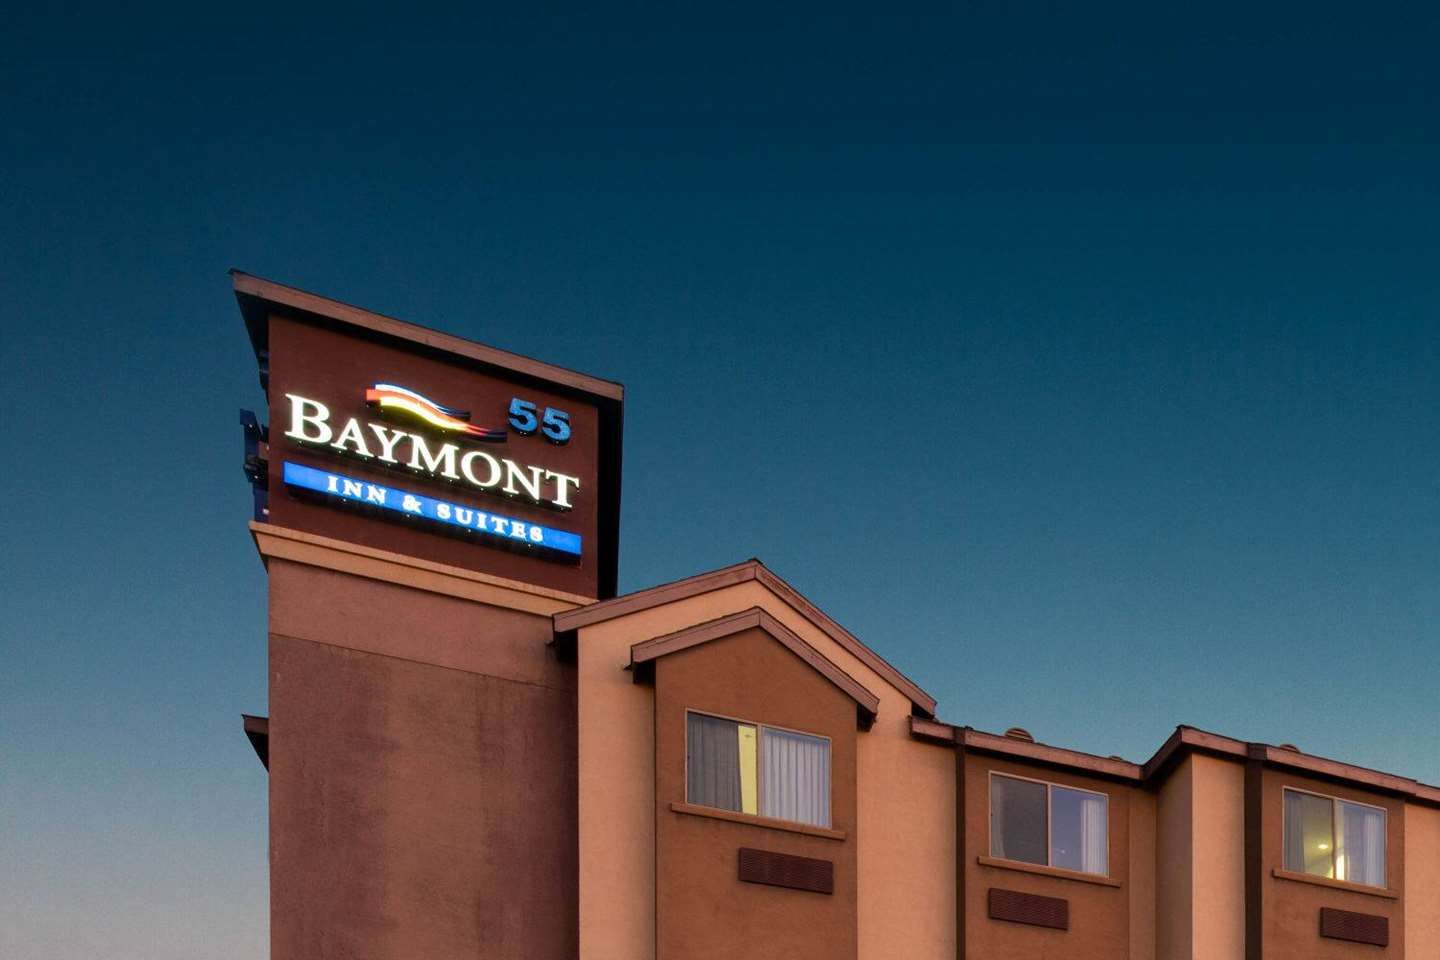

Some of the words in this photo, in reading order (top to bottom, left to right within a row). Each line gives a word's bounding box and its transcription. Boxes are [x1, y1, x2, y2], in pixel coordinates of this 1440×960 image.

[285, 393, 580, 508] BAYMONT
[509, 398, 572, 444] 55
[327, 475, 386, 504] INN
[402, 494, 424, 513] &
[437, 503, 544, 543] SUITES
